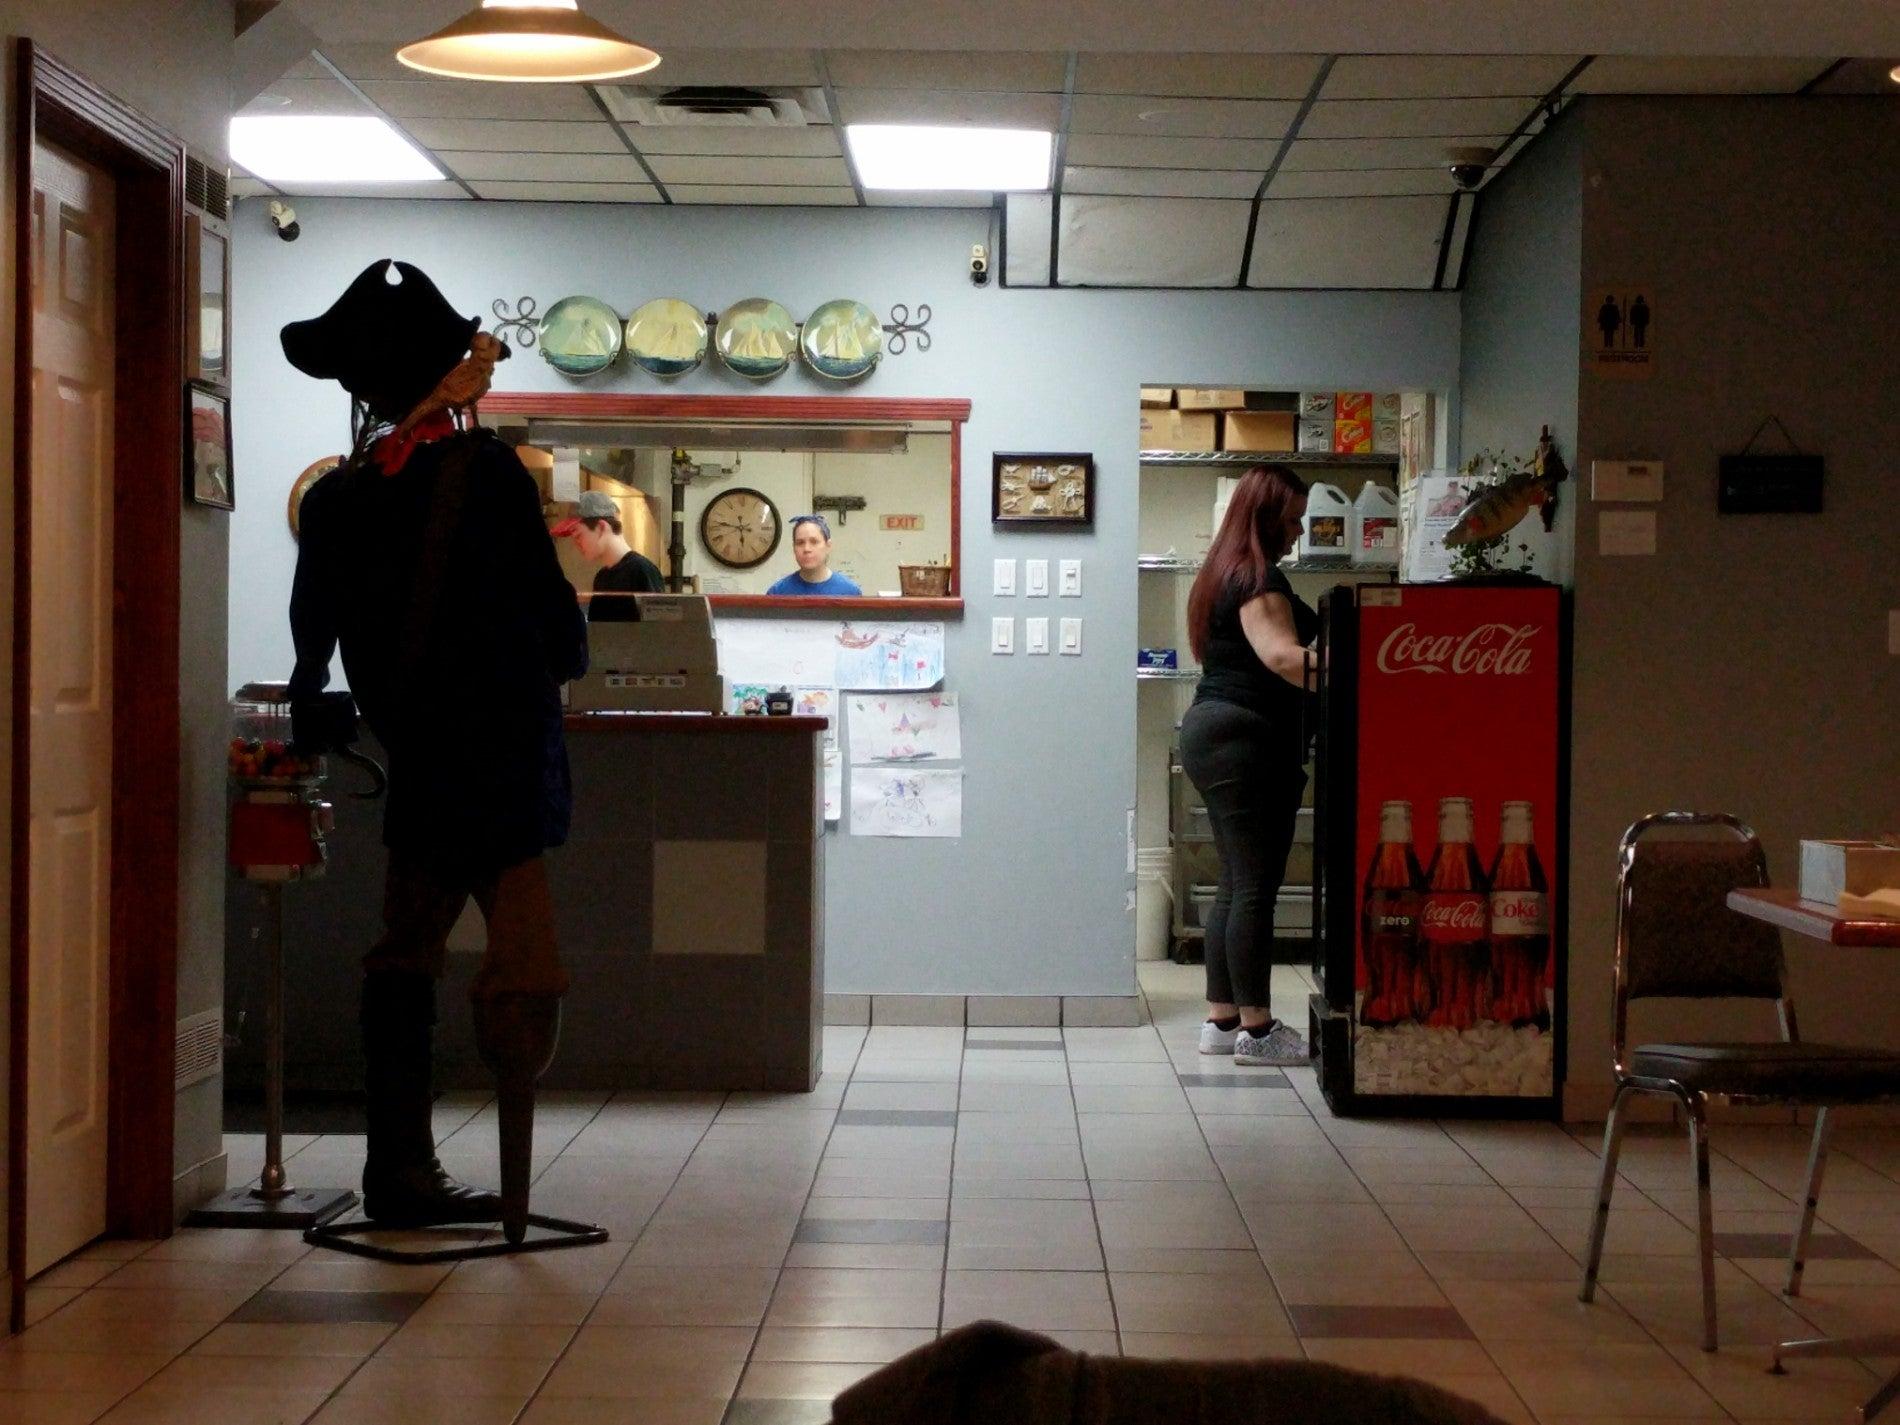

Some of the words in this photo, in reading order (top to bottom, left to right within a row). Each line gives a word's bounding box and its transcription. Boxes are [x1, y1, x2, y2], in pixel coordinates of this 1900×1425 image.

[886, 517, 917, 528] EXIT
[1377, 622, 1543, 675] Coca-Cola
[1492, 897, 1539, 918] Coke
[1380, 915, 1410, 927] zero
